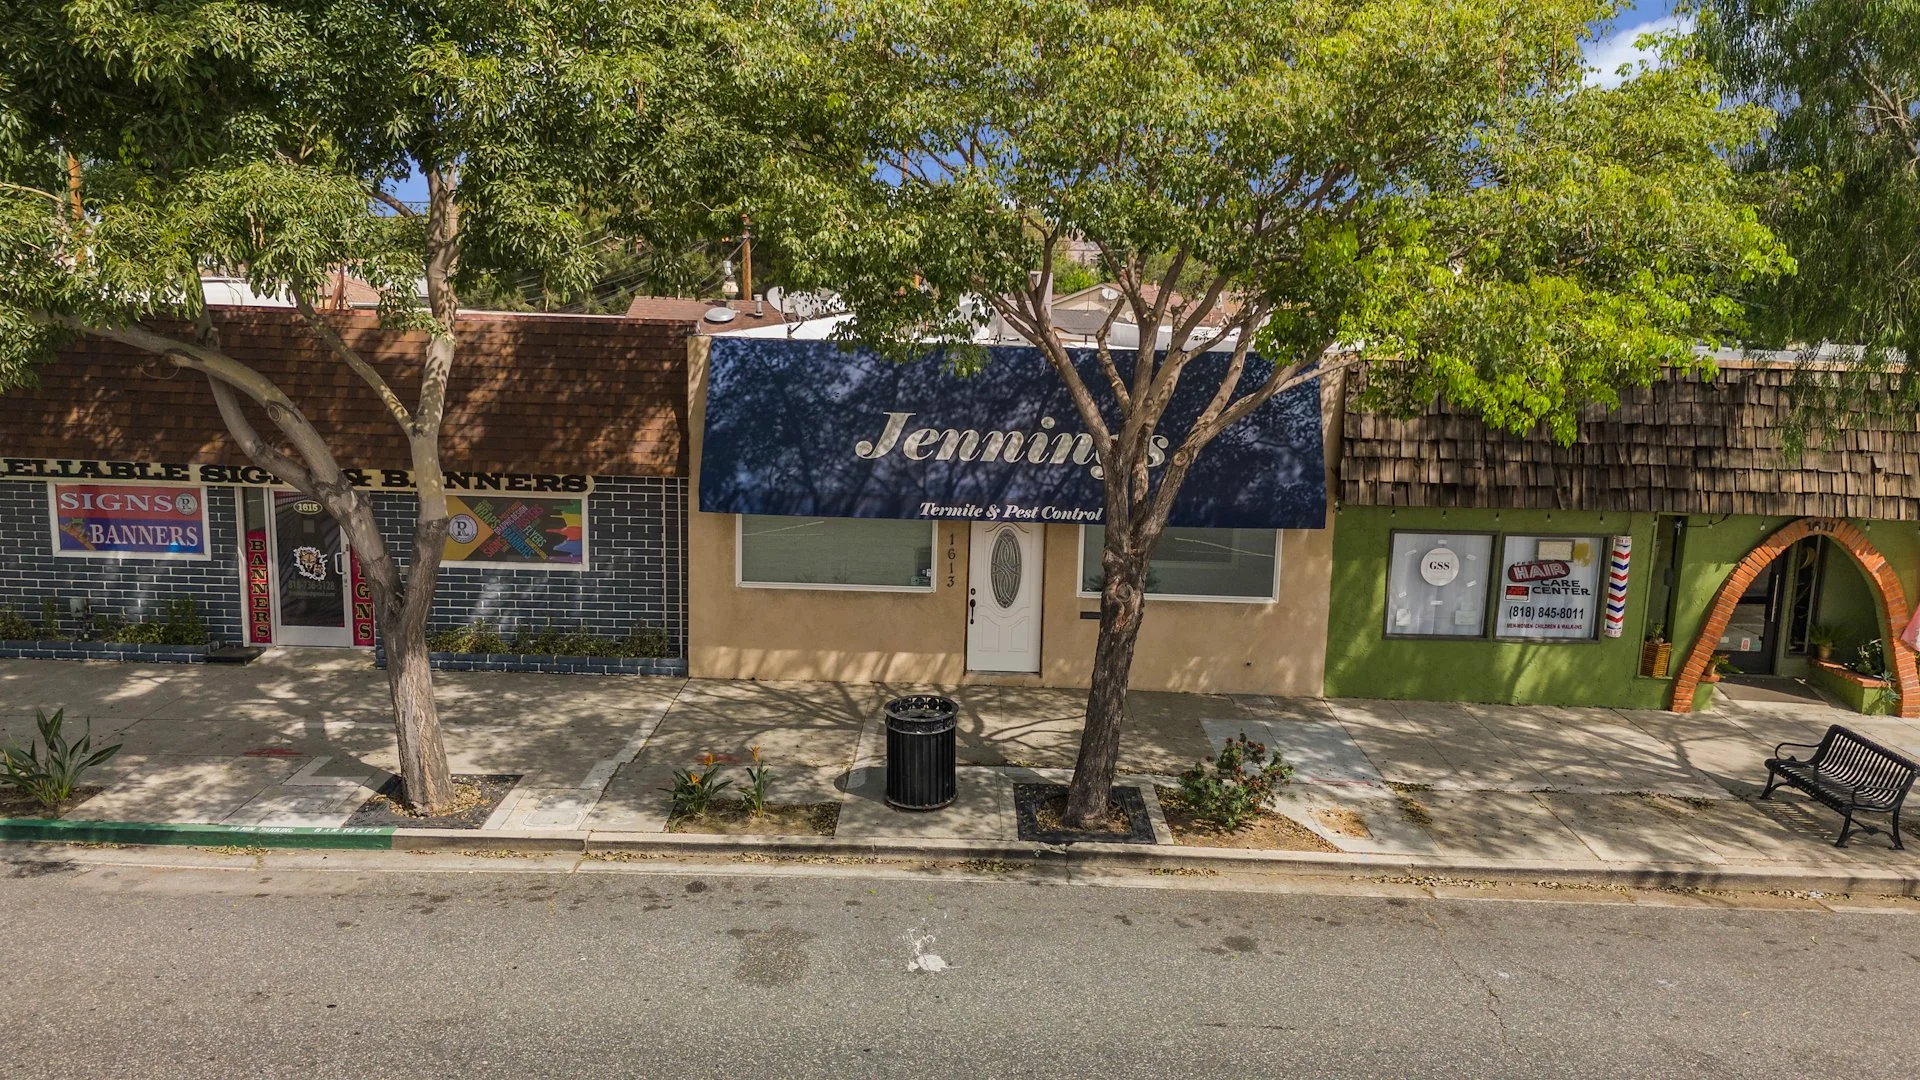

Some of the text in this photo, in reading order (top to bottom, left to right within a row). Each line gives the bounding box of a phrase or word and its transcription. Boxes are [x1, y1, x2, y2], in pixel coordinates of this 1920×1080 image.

[855, 411, 1169, 479] Jennins
[0, 458, 588, 492] ELIABLE SIG & BNNERS
[60, 492, 173, 512] SIGNS
[297, 503, 318, 511] 1615
[919, 502, 1104, 521] Termite & Pest Control
[473, 502, 500, 529] WRAPS
[90, 524, 198, 546] BANNERS
[523, 525, 547, 547] FLYERS
[1429, 561, 1450, 570] GSS
[1513, 562, 1566, 580] HAIR
[250, 540, 269, 637] BANNERS
[1532, 586, 1591, 596] CENTER
[1540, 580, 1581, 588] CARE
[1509, 605, 1584, 620] (818) 845-8011
